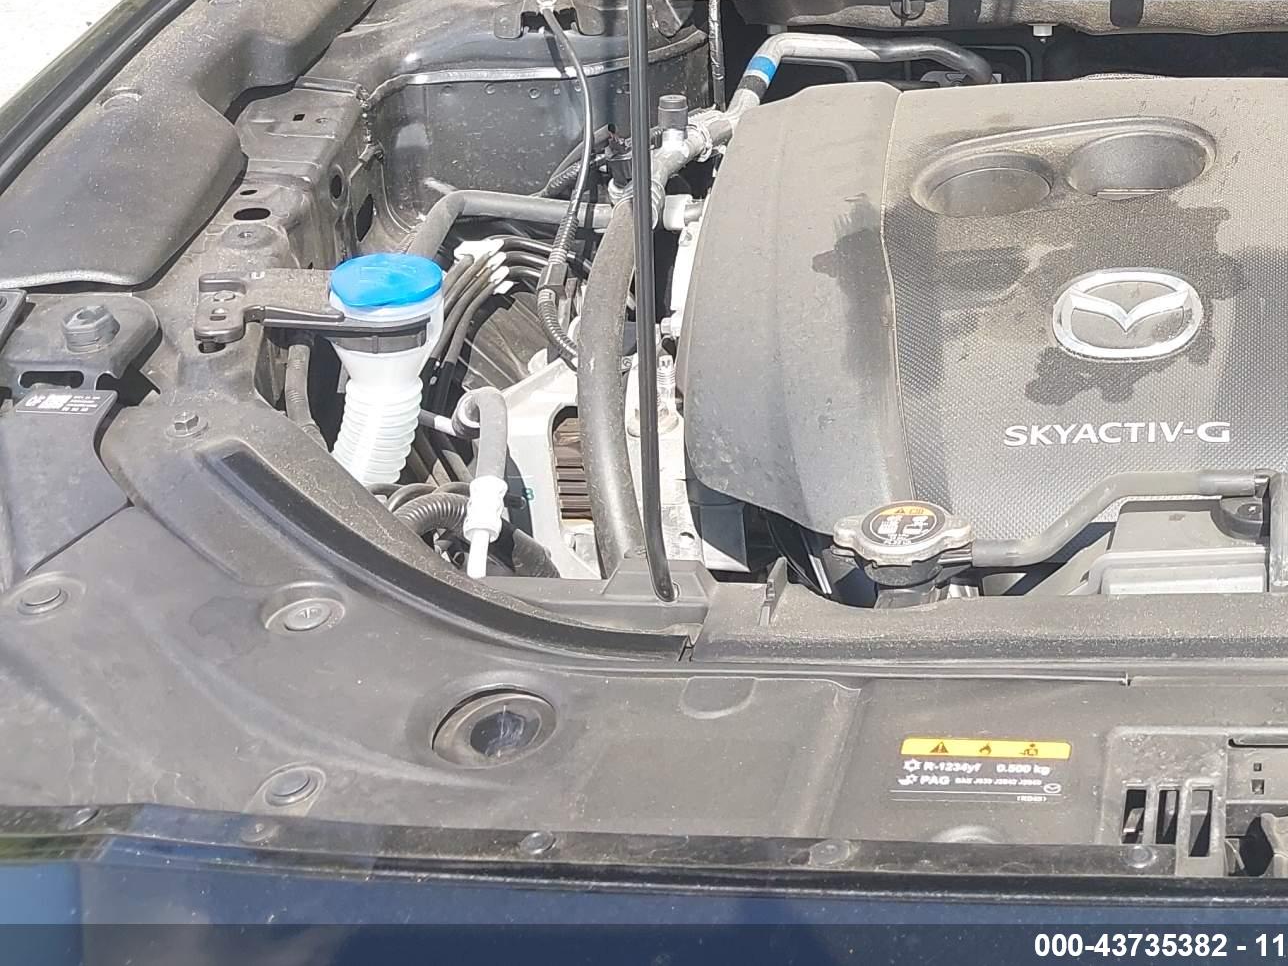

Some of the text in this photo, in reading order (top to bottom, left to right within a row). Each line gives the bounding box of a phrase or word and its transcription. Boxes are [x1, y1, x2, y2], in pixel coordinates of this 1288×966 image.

[1003, 420, 1231, 447] SKYACTIV-G
[922, 761, 982, 774] R-1234yf
[1033, 764, 1051, 776] kg
[919, 775, 951, 785] PAG
